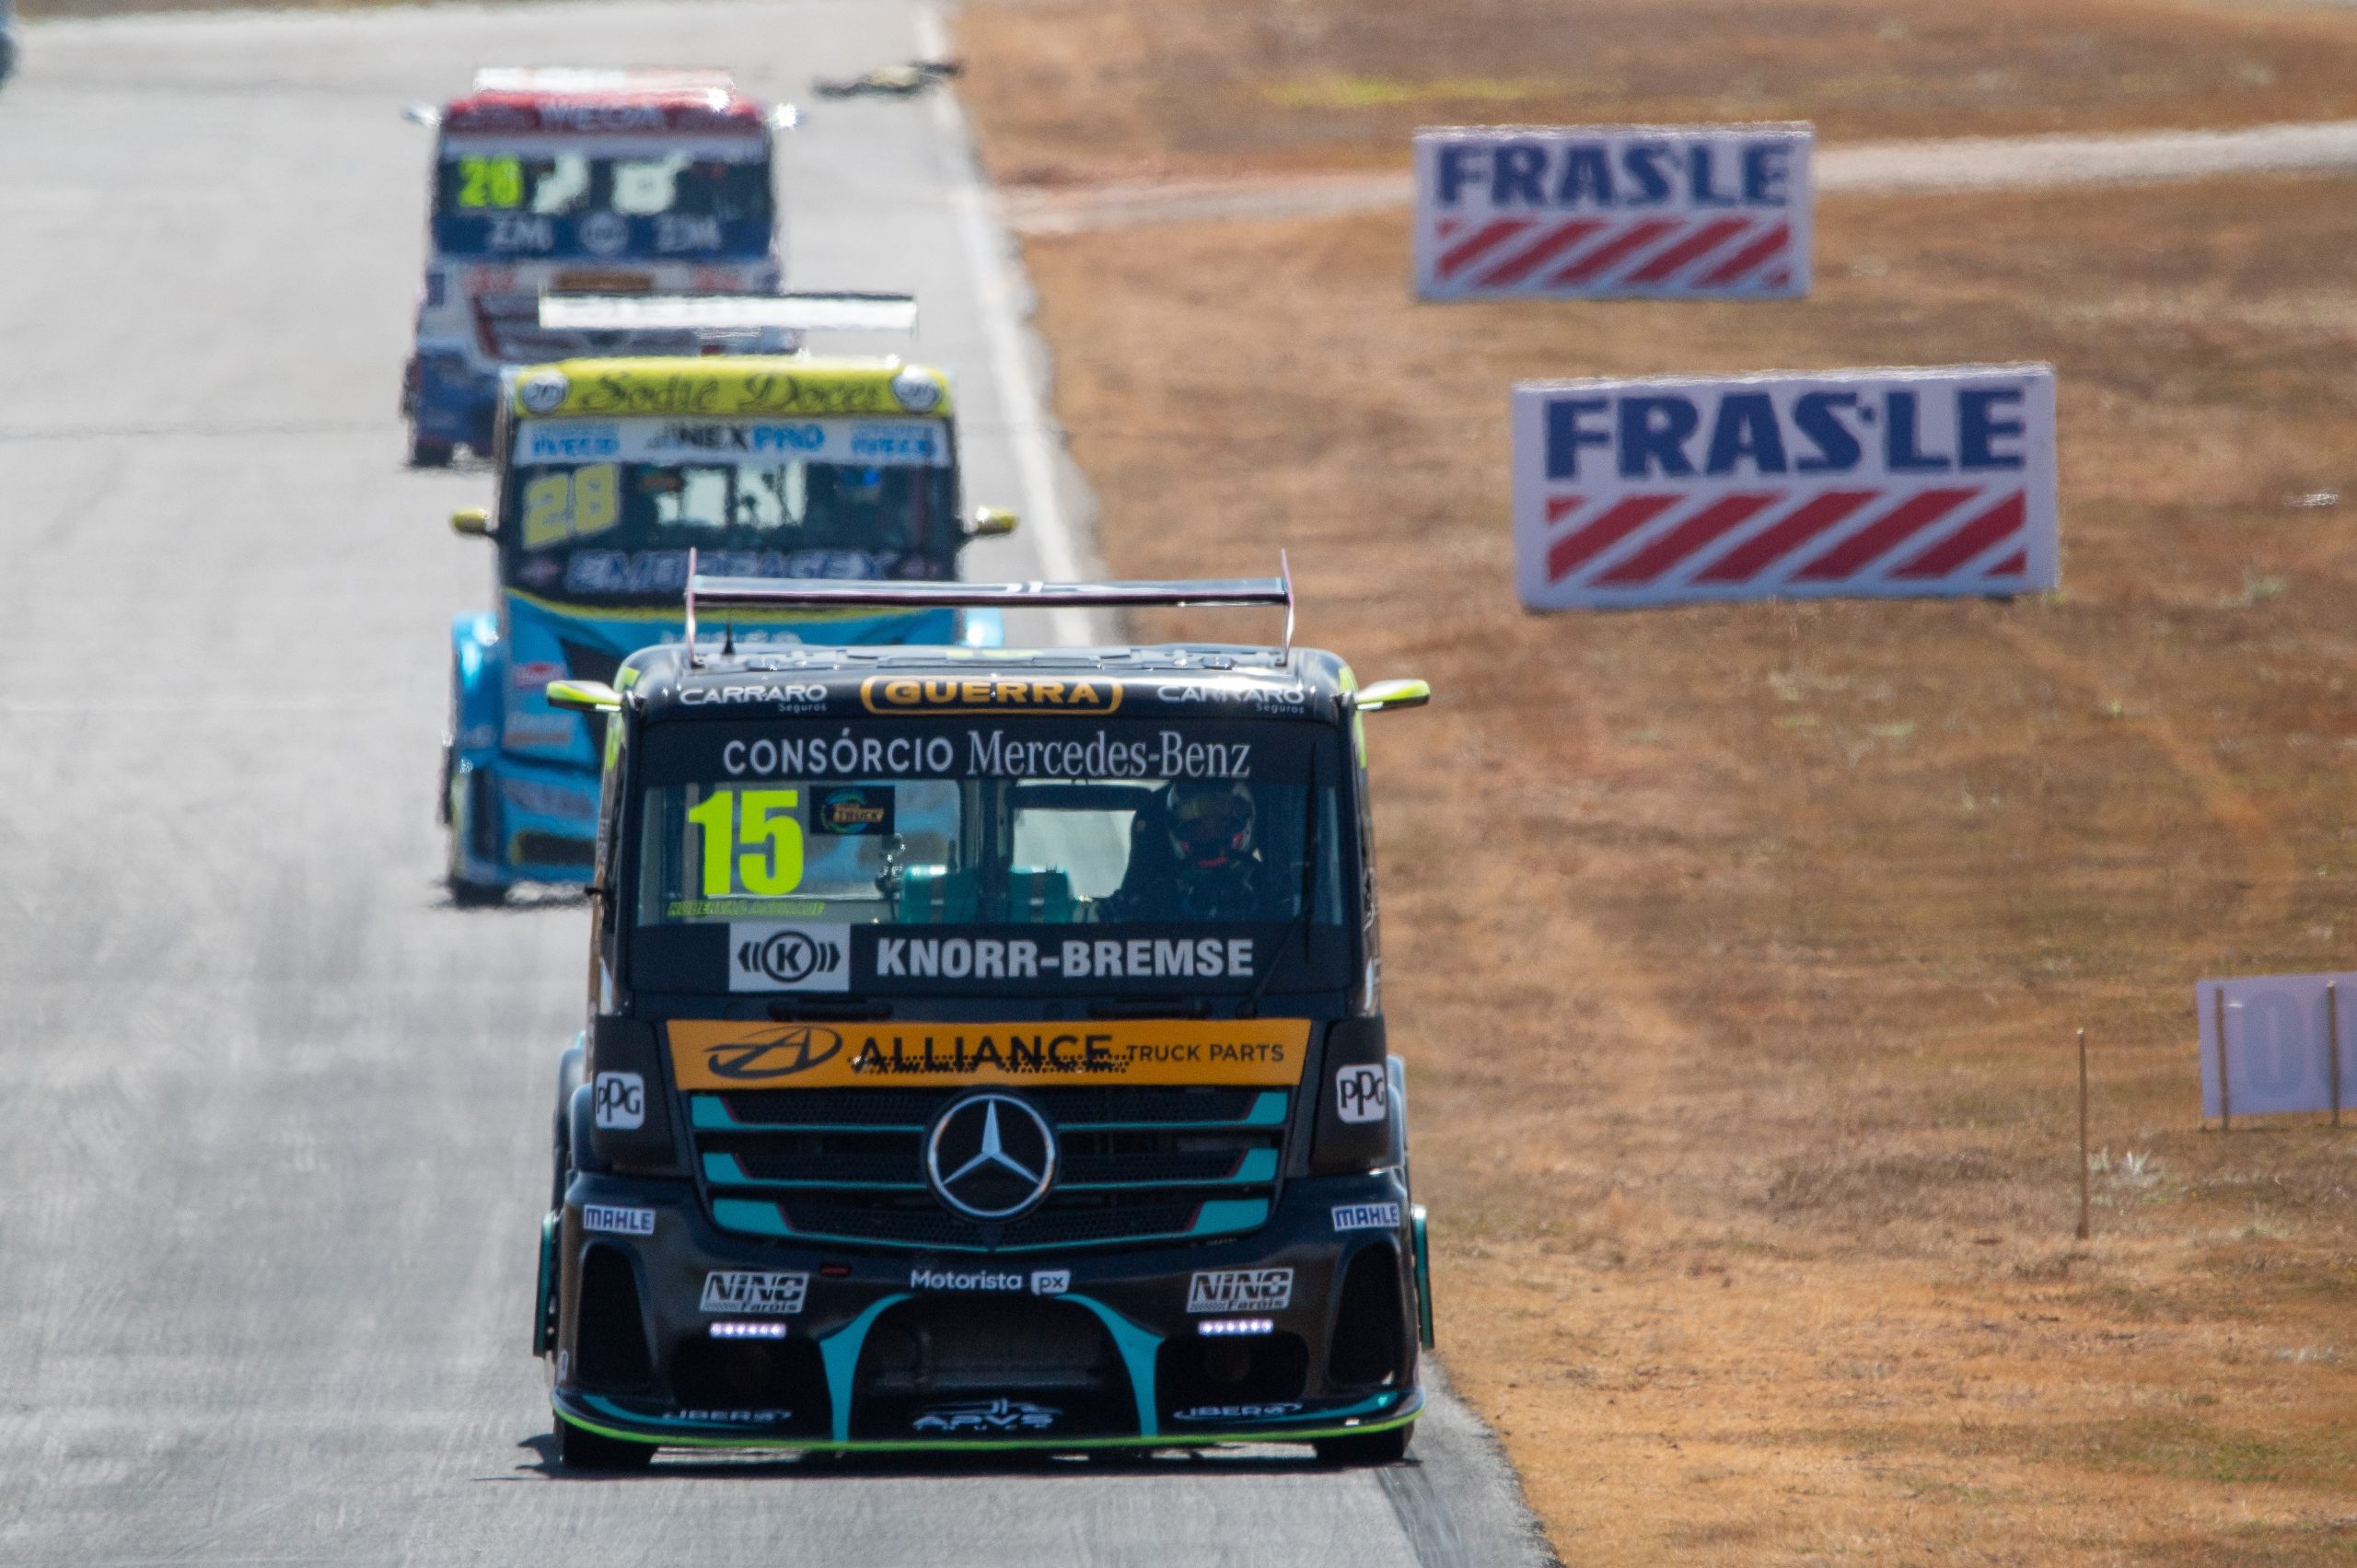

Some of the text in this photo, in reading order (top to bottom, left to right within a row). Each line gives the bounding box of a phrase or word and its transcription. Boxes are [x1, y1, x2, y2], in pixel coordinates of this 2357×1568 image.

[679, 684, 828, 705] CARRARO
[884, 680, 1101, 704] GUERRA
[1156, 684, 1306, 703] CARRARO
[778, 703, 828, 714] Seguros
[1256, 703, 1306, 715] Seguros
[722, 727, 1252, 778] CONSÓRCIO Mercedes-Benz
[688, 789, 805, 896] 15
[876, 938, 1255, 979] KNORR-BREMSE
[850, 1033, 1284, 1074] ALLIANCE TRUCK PARTS
[597, 1077, 642, 1122] PPG
[586, 1208, 653, 1232] MAHLE
[1335, 1204, 1399, 1228] MAHLE
[910, 1270, 1023, 1290] Motorista
